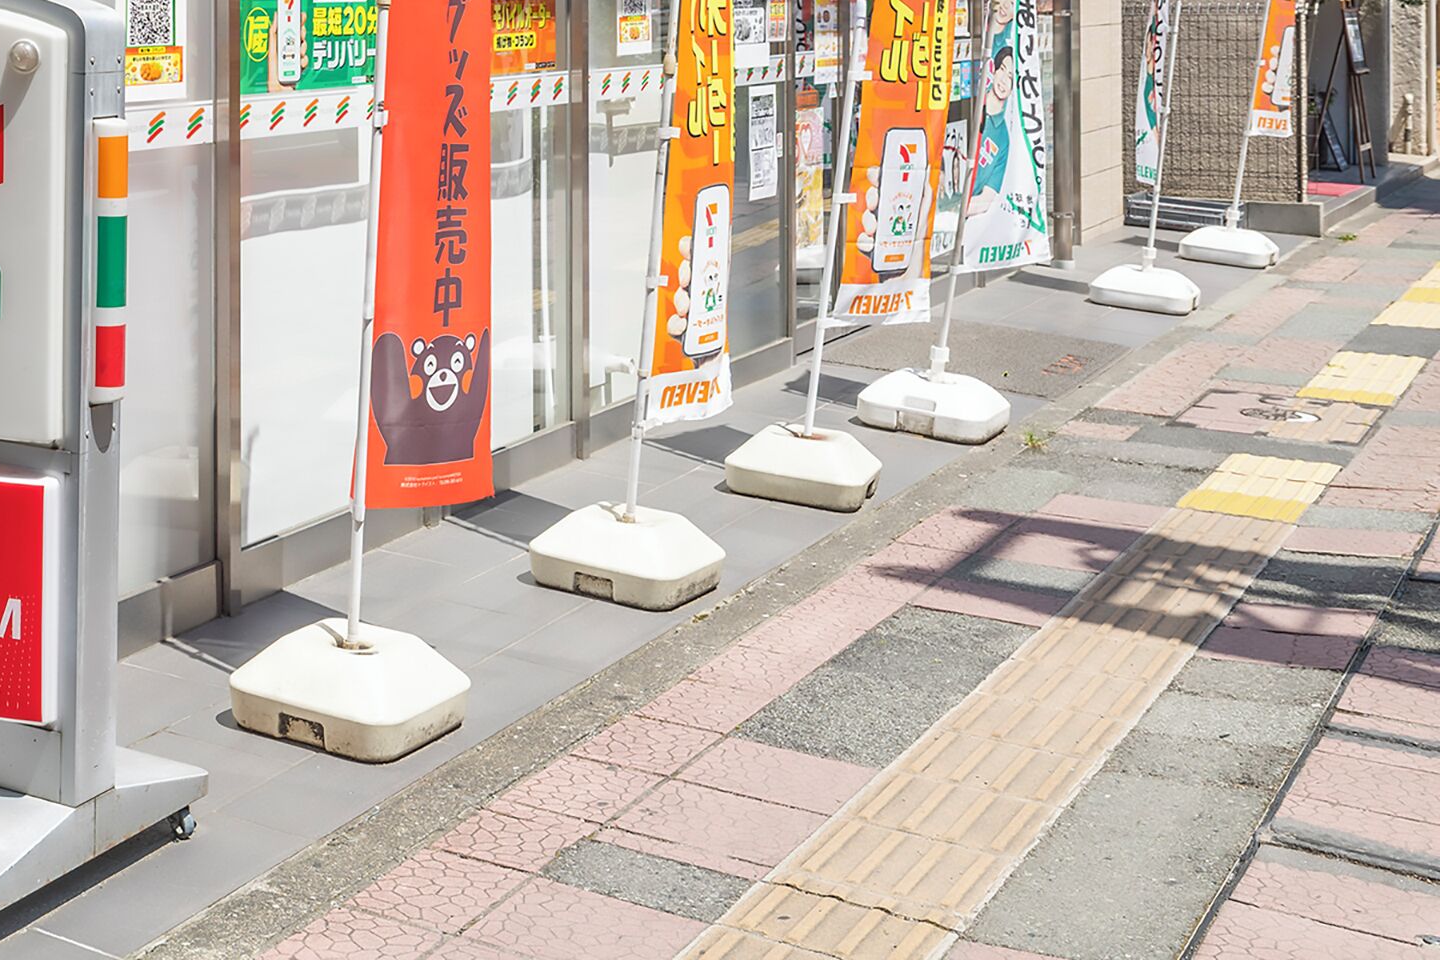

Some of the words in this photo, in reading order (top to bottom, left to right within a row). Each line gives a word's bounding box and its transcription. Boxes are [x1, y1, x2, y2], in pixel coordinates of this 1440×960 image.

[313, 39, 377, 71] デリバリー
